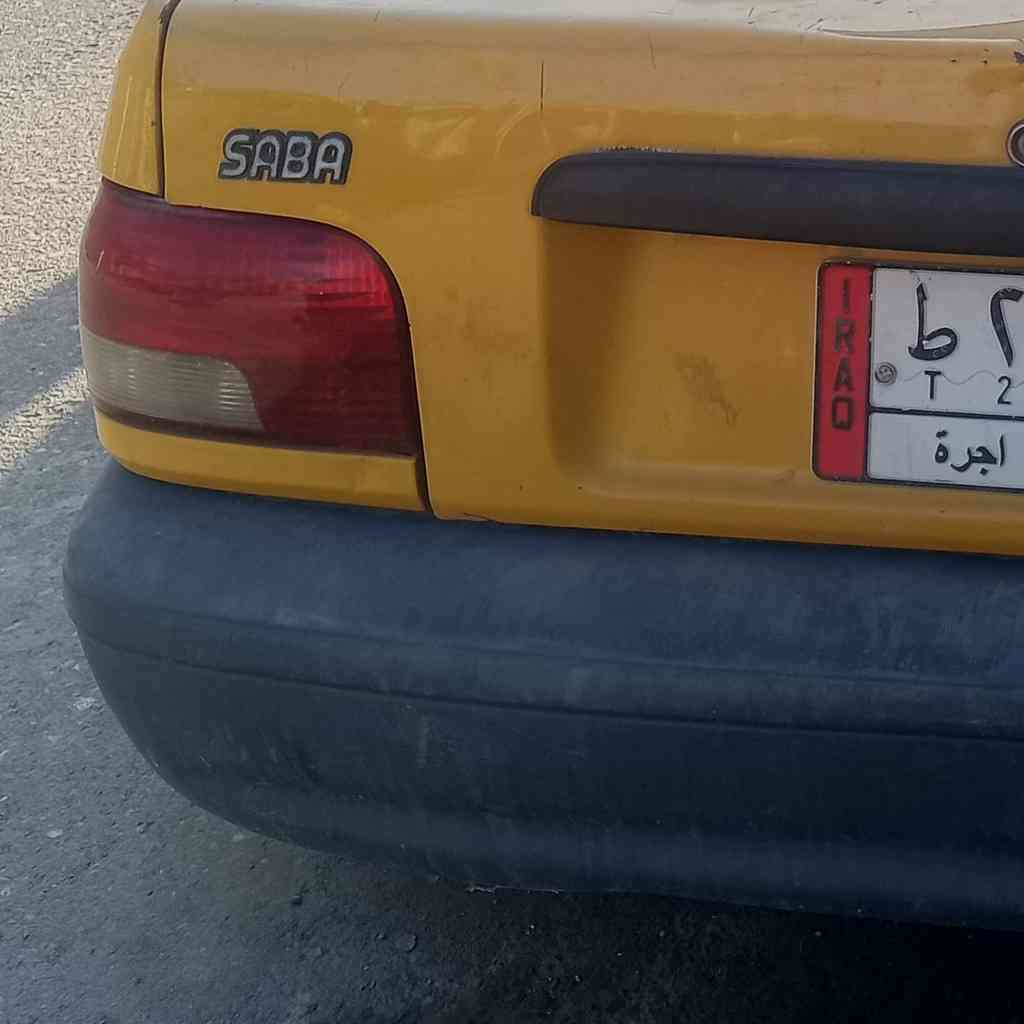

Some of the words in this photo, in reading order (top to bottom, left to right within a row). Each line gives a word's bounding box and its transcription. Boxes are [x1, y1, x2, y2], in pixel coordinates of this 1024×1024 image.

[218, 127, 353, 185] SABA
[908, 281, 959, 362] ط
[830, 280, 855, 432] IRAQ
[924, 369, 942, 401] T
[934, 429, 1007, 477] اجرة
